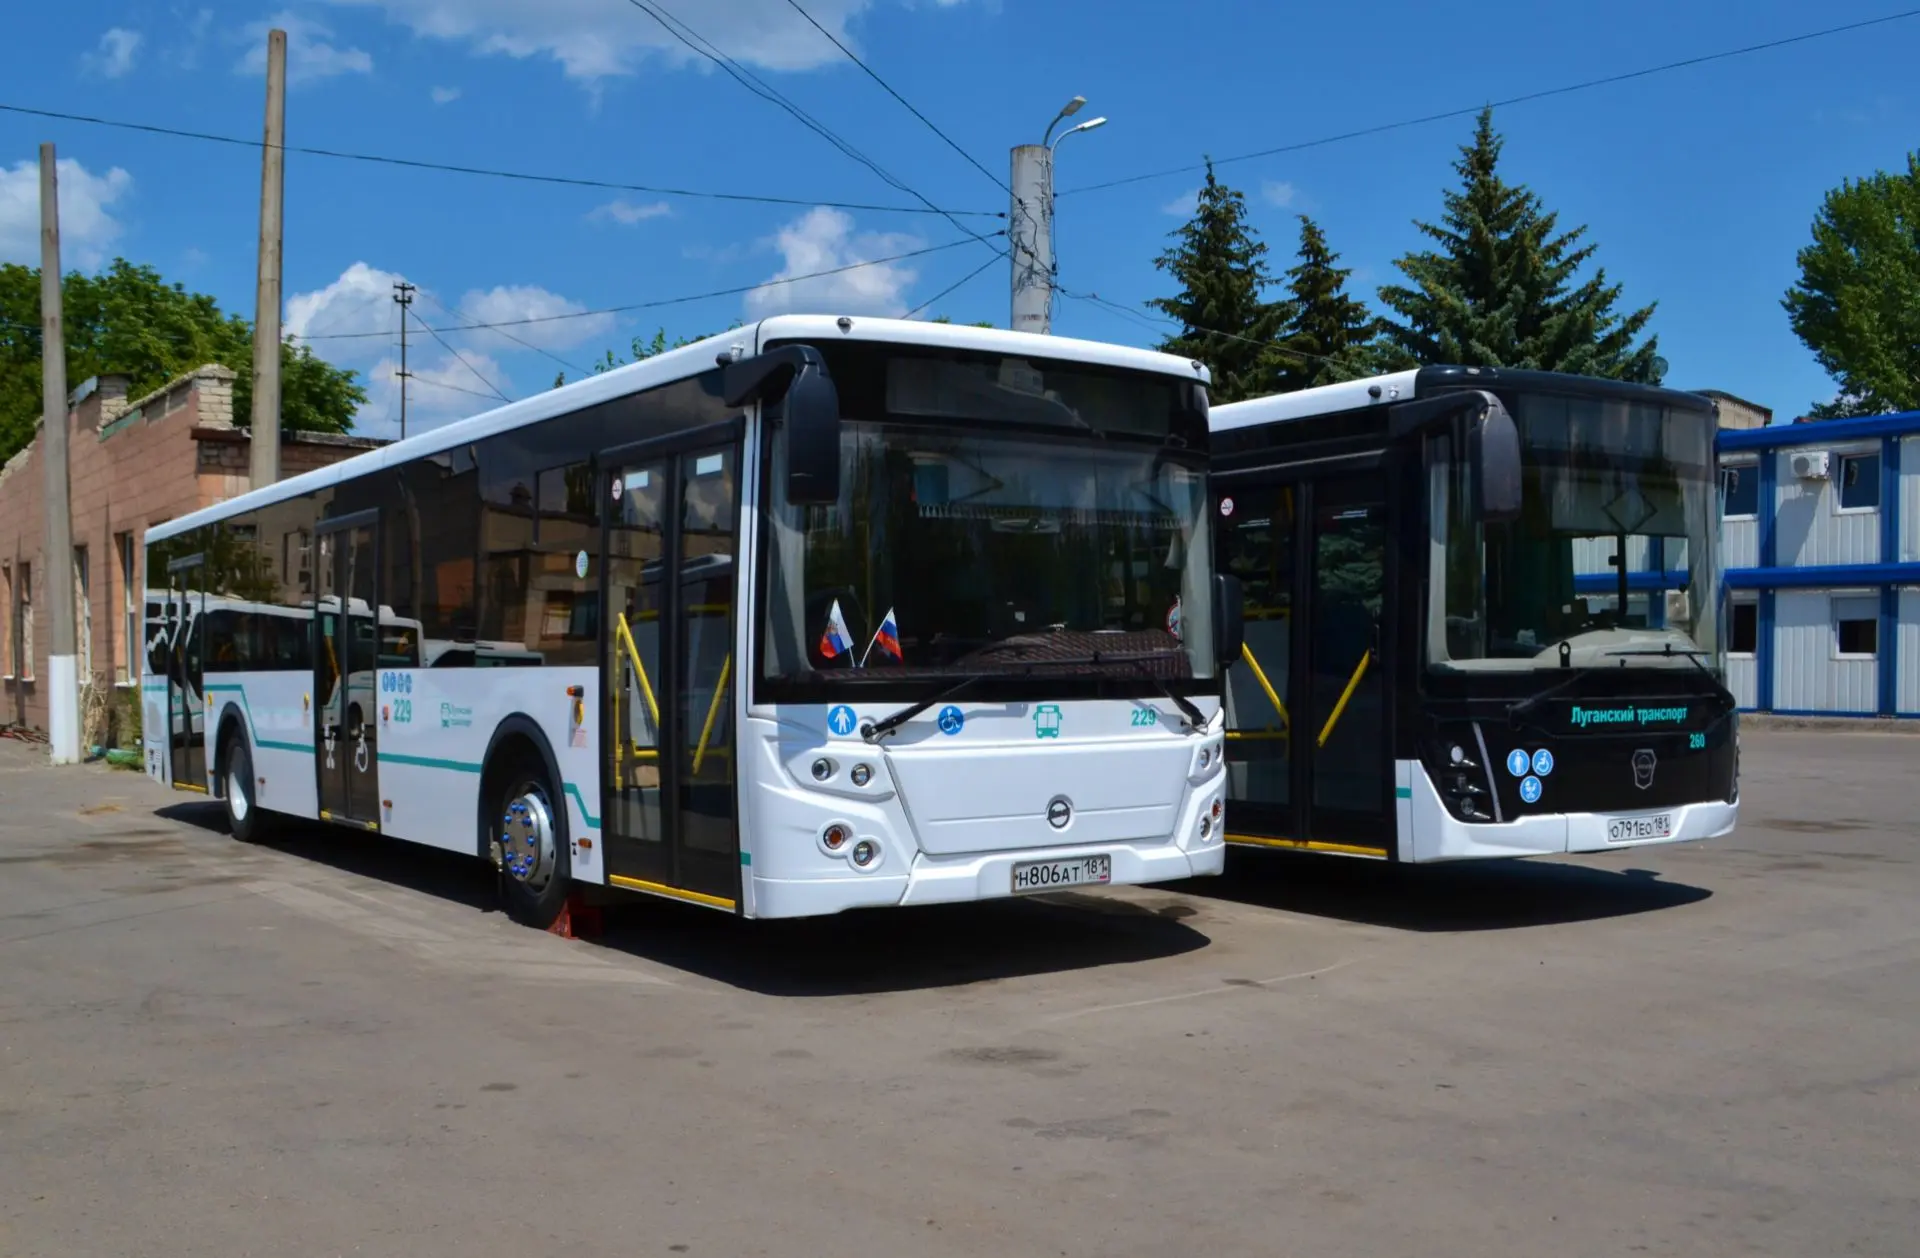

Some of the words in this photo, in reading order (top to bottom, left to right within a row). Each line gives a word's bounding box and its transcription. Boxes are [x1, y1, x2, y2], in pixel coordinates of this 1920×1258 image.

[394, 698, 412, 723] 229
[1131, 708, 1156, 726] 229
[1571, 705, 1635, 728] Луганский
[1637, 706, 1688, 725] транспорт
[1611, 820, 1652, 838] О791ЕО
[1018, 864, 1080, 887] Н806АТ
[1084, 858, 1105, 875] 181
